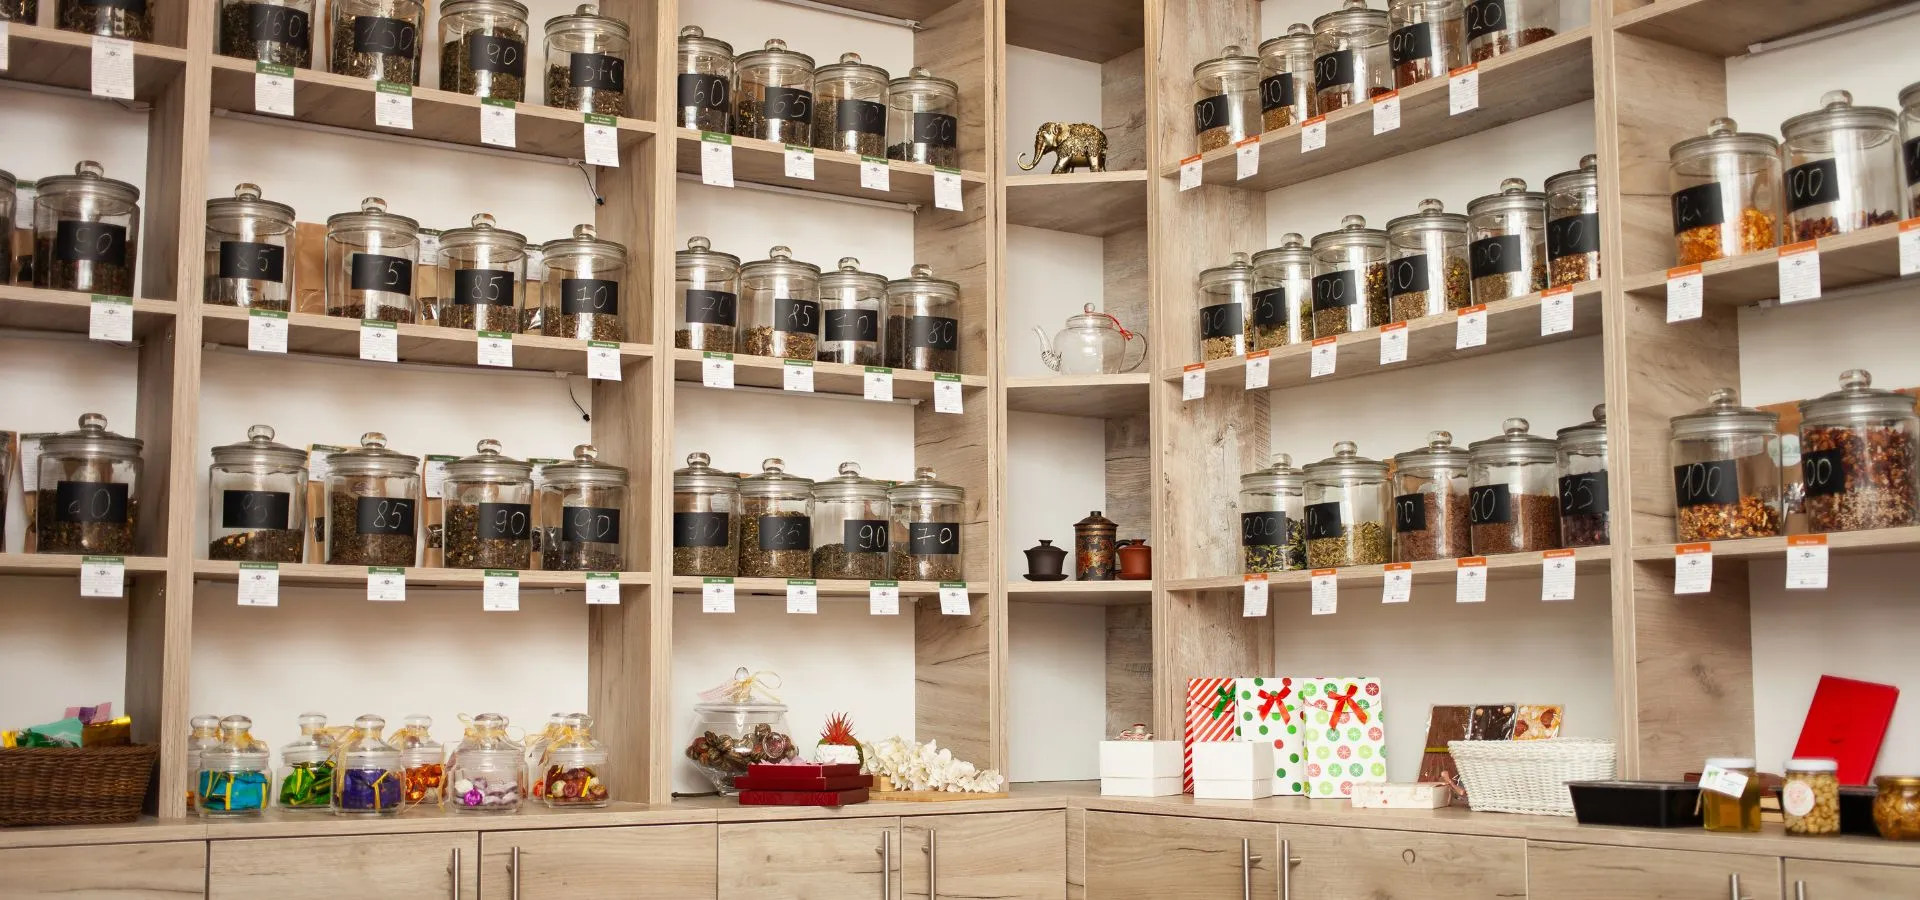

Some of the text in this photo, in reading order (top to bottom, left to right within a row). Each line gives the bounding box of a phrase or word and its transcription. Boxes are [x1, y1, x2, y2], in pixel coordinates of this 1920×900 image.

[694, 79, 724, 106] 60
[472, 275, 504, 301] 85
[576, 286, 608, 309] 70
[1682, 462, 1722, 501] 100
[373, 500, 408, 529] 85
[493, 509, 525, 535] 90
[574, 508, 610, 540] 90
[859, 524, 886, 549] 90
[916, 527, 952, 545] 70
[1244, 516, 1277, 540] 200
